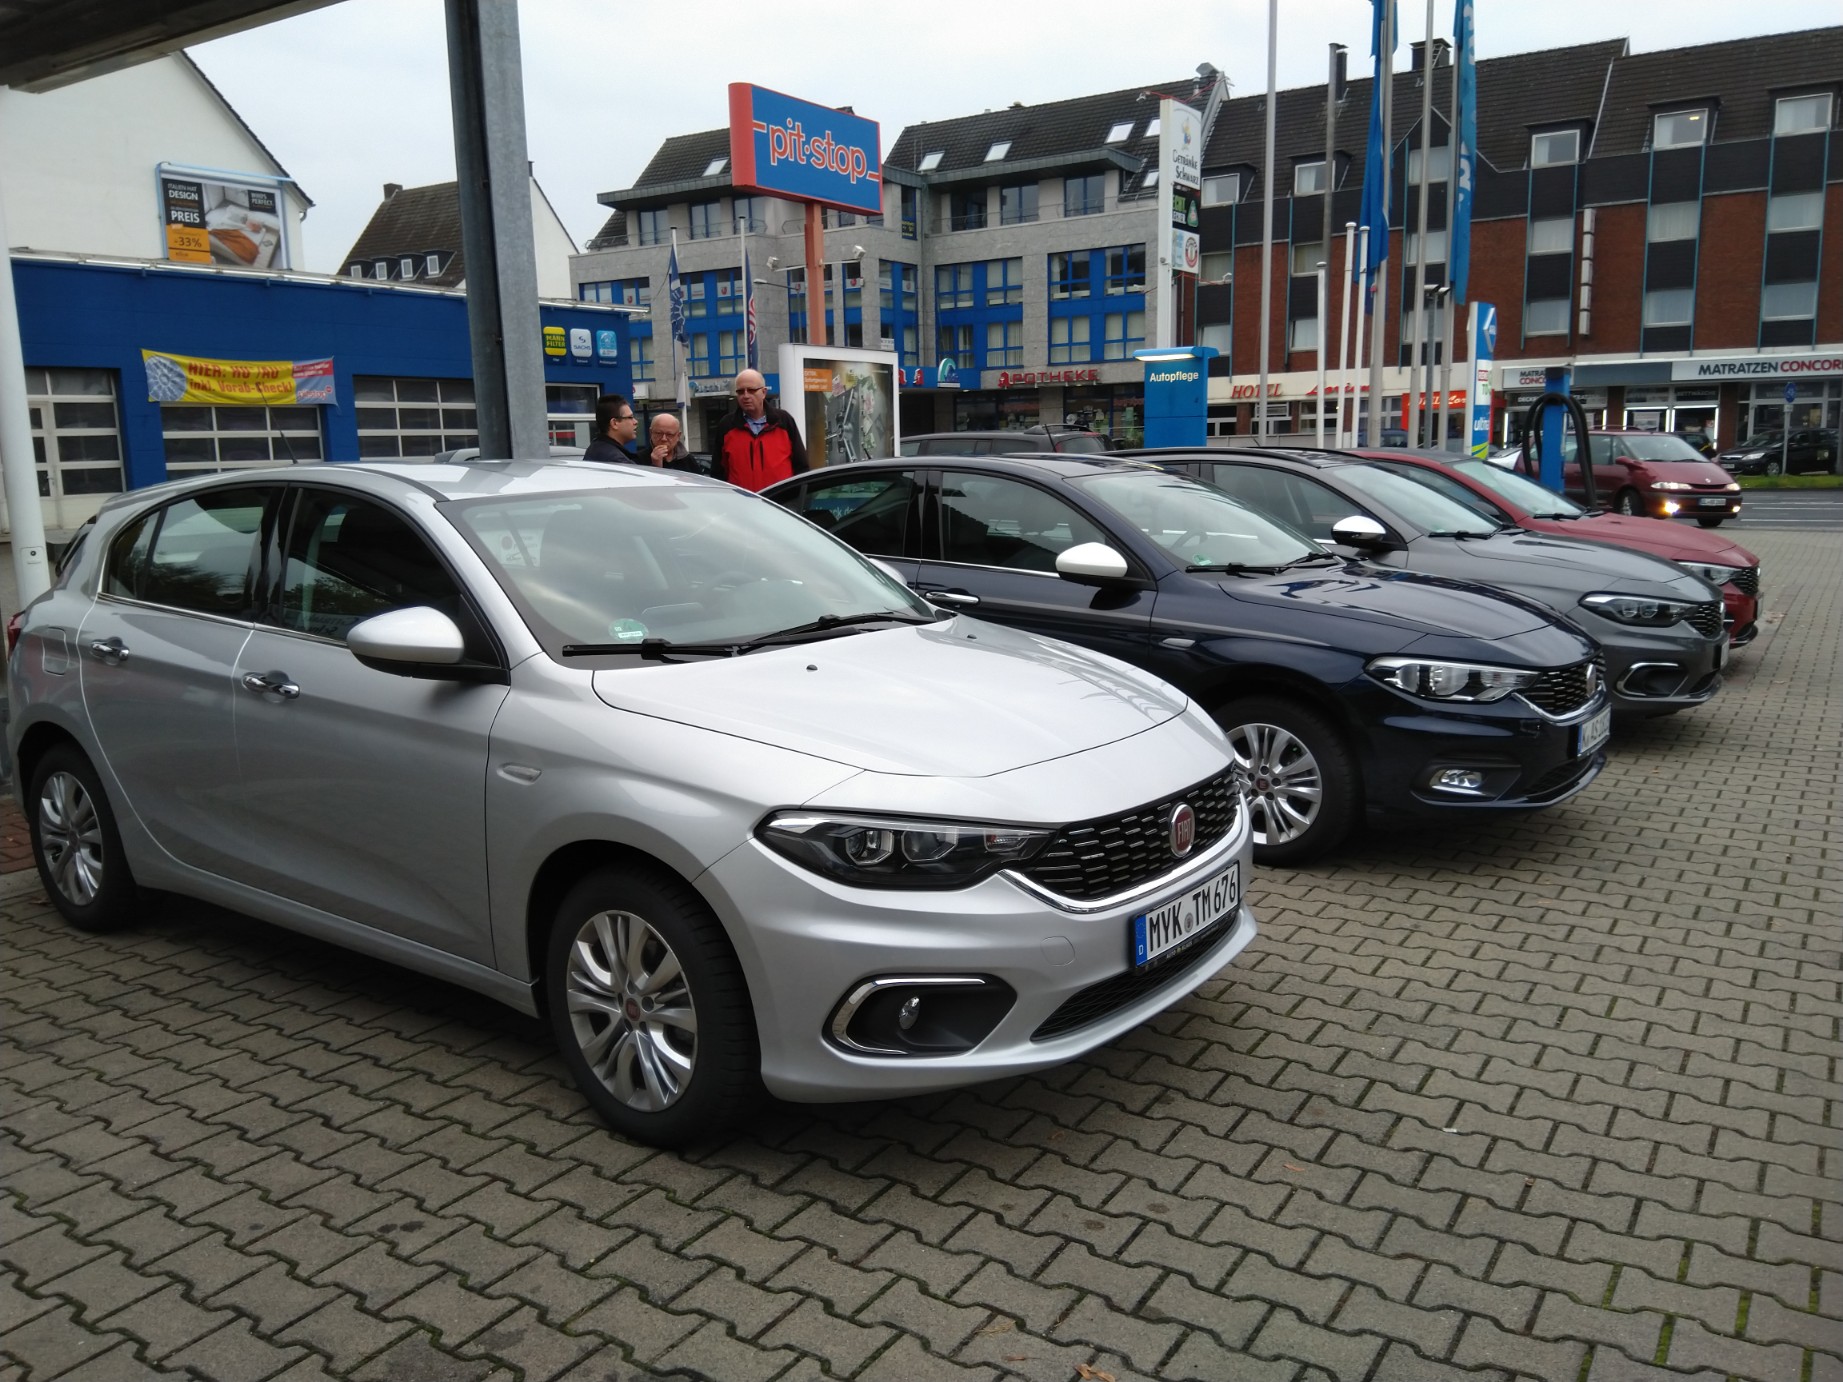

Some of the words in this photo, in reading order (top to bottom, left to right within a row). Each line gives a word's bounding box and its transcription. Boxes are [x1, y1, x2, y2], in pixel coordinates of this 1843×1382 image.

[168, 190, 198, 201] DESIGN
[170, 210, 200, 223] PREIS
[1698, 361, 1779, 375] MATRATZEN
[1780, 358, 1843, 373] CONCOR
[998, 368, 1099, 389] APOTHEKE
[1149, 371, 1199, 383] Autopflege
[1177, 820, 1192, 843] FIAT
[1149, 902, 1183, 952] MYK
[1192, 884, 1211, 926] TM
[1213, 869, 1236, 914] 676
[1138, 945, 1144, 956] D
